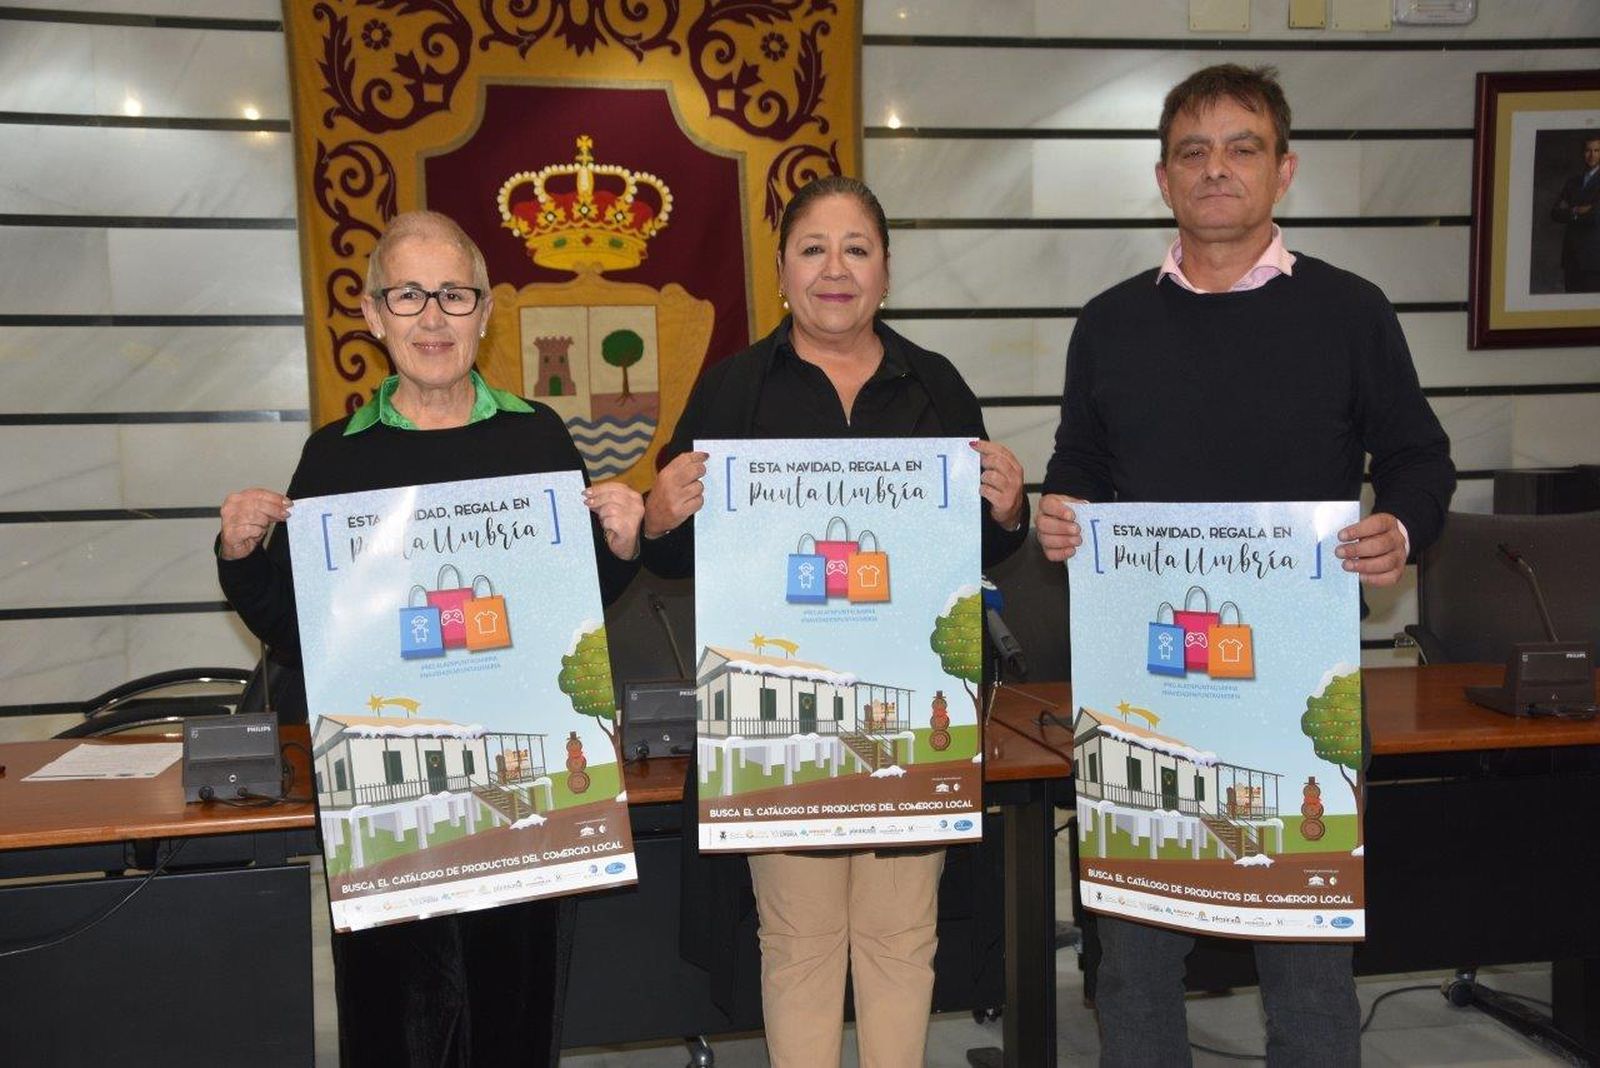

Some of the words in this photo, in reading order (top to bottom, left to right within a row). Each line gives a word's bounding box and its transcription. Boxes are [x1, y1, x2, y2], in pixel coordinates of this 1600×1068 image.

[750, 462, 781, 474] ESTA
[787, 462, 845, 474] NAVIDAD,
[850, 461, 900, 472] REGALA
[906, 460, 922, 471] EN
[750, 476, 821, 508] Punta
[827, 476, 927, 509] Umbría
[347, 514, 381, 528] ESTA
[454, 501, 509, 516] REGALA
[513, 498, 530, 510] EN
[433, 516, 537, 554] Umbría
[1113, 525, 1143, 537] ESTA
[1146, 526, 1205, 540] NAVIDAD,
[1209, 526, 1267, 538] REGALA
[1273, 527, 1292, 538] EN
[1115, 542, 1180, 576] Punta
[1186, 543, 1299, 580] Umbría
[710, 809, 740, 818] BUSCA
[744, 808, 754, 816] EL
[757, 805, 804, 816] CATÁLOGO
[807, 806, 819, 814] DE
[822, 802, 877, 813] PRODUCTOS
[879, 802, 896, 811] DEL
[898, 800, 944, 810] COMERCIO
[946, 800, 973, 808] LOCAL
[342, 880, 375, 894] BUSCA
[378, 878, 390, 888] EL
[392, 868, 444, 886] CATÁLOGO
[446, 866, 460, 877] DE
[462, 856, 520, 874] PRODUCTOS
[522, 854, 540, 864] DEL
[543, 846, 590, 860] COMERCIO
[592, 840, 624, 852] LOCAL
[1088, 868, 1114, 881] BUSCA
[1116, 874, 1125, 884] EL
[1127, 876, 1170, 892] CATÁLOGO
[1171, 884, 1182, 894] DE
[1184, 887, 1241, 900] PRODUCTOS
[1244, 893, 1262, 902] DEL
[1266, 894, 1317, 904] COMERCIO
[1320, 894, 1354, 904] LOCAL
